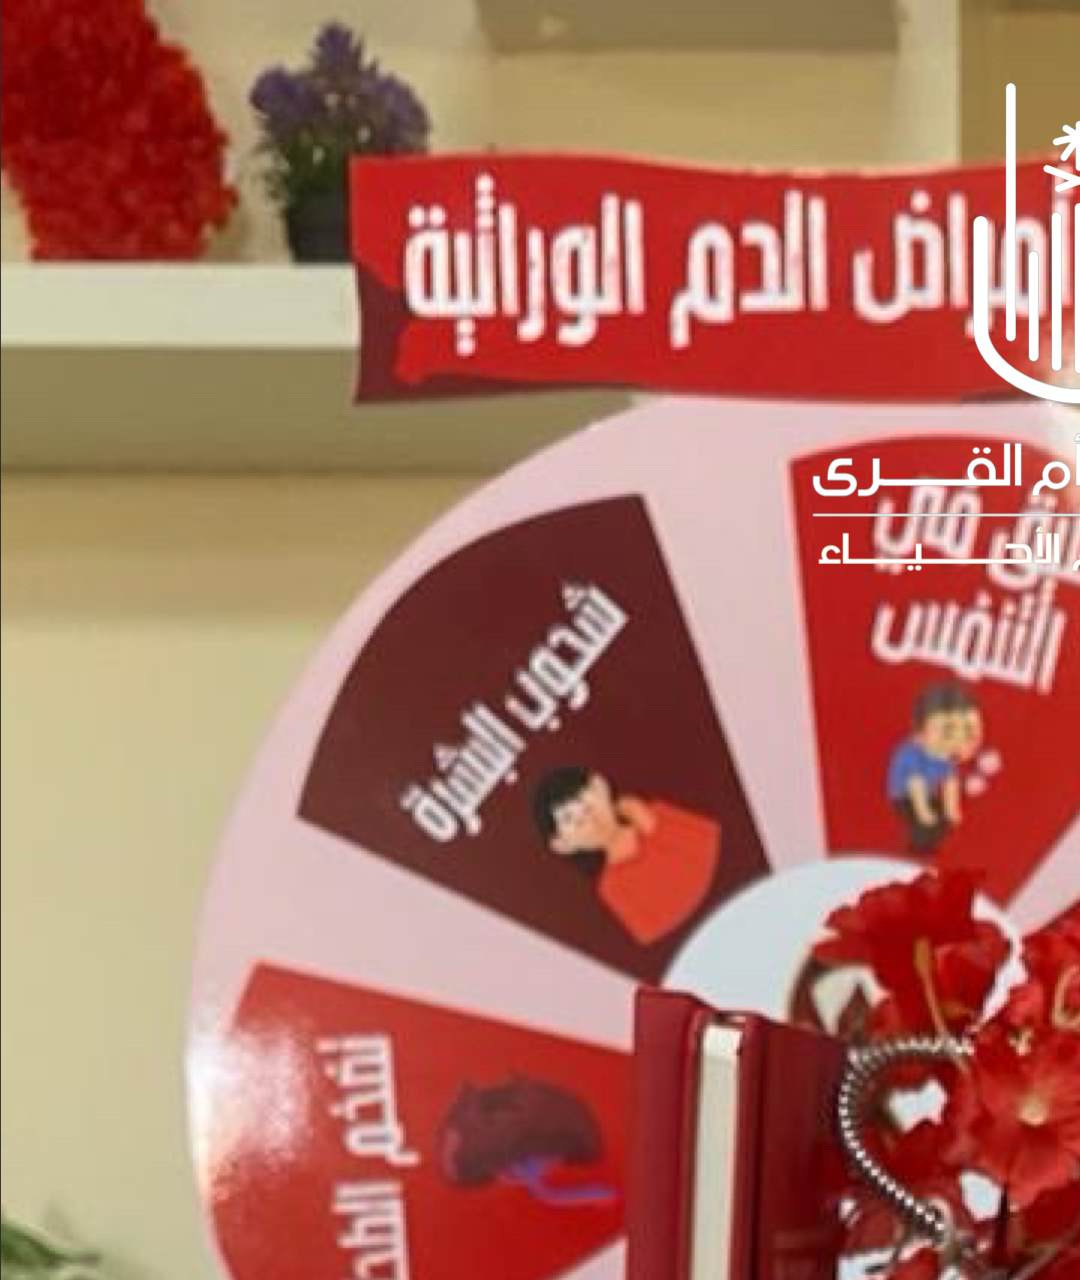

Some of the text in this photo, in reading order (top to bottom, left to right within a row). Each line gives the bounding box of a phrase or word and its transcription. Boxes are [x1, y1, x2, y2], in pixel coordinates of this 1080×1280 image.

[404, 172, 645, 357] الوراثية
[670, 188, 830, 349] الدم
[400, 579, 630, 844] شحوب البشرة
[869, 577, 1066, 694] التنفس
[316, 1034, 421, 1168] تضخم
